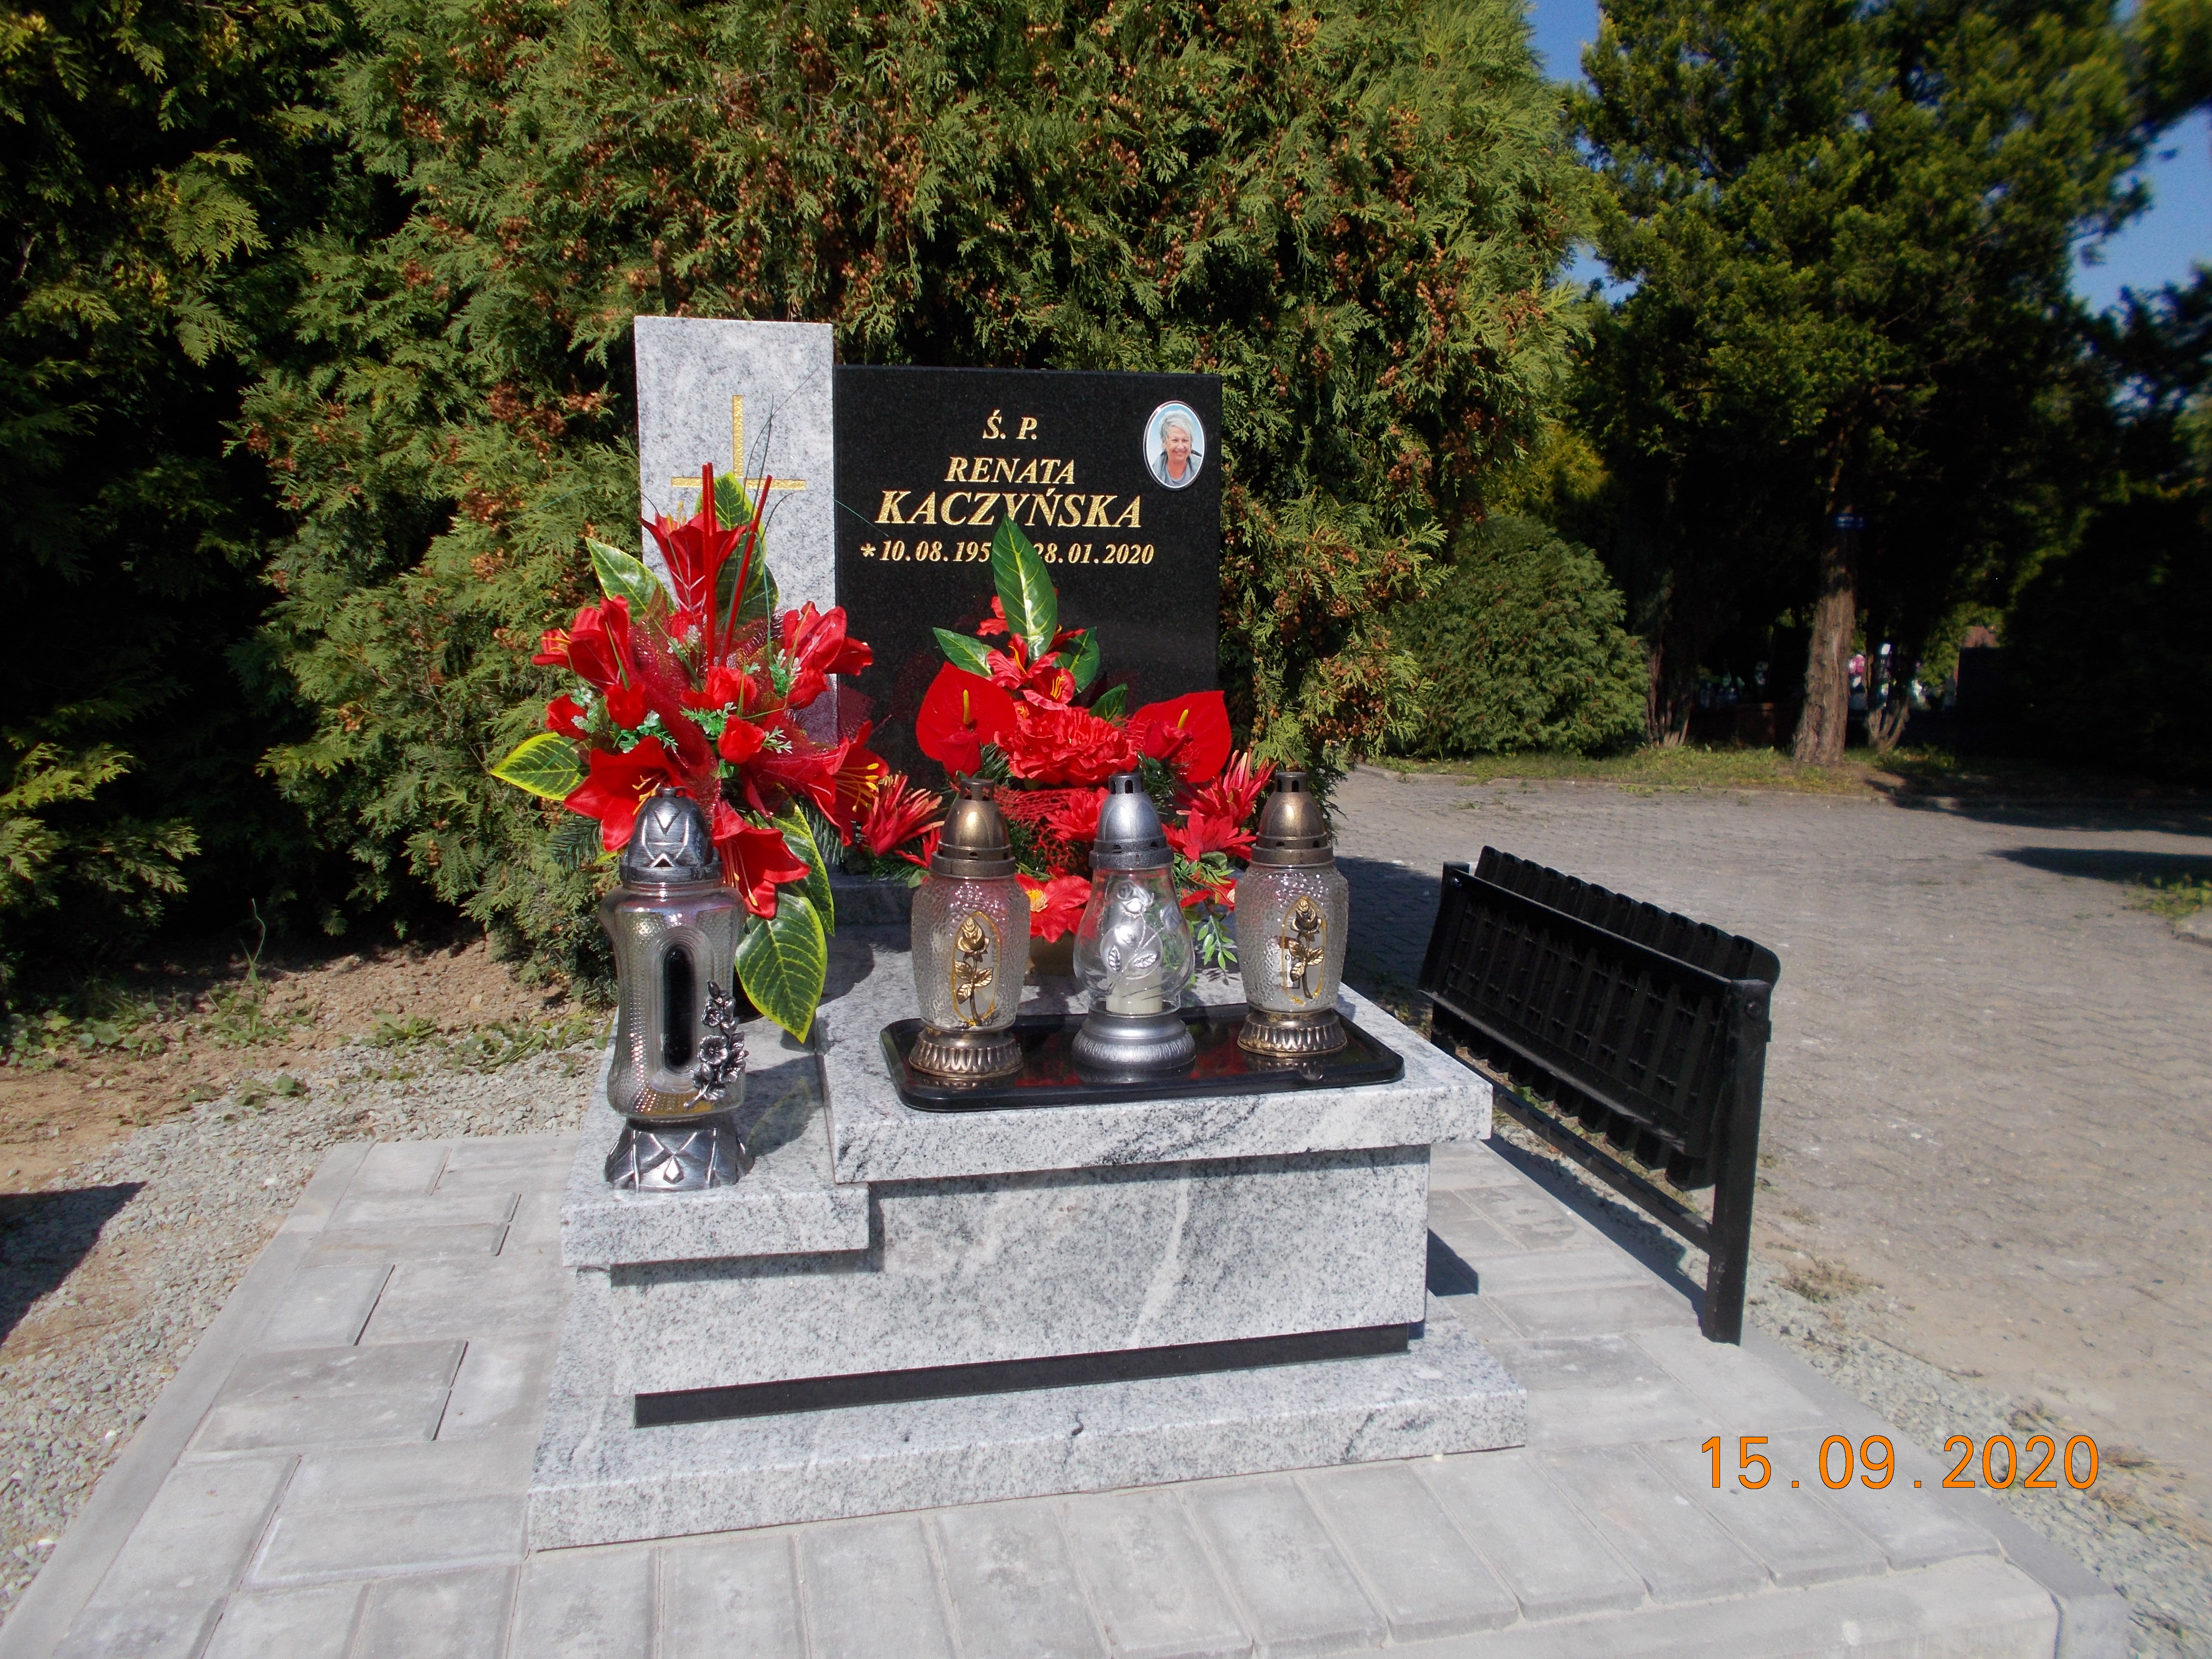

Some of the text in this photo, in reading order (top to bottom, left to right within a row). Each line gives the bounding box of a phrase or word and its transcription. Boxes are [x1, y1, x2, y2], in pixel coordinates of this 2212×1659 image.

[982, 409, 1037, 440] Ś. P.
[944, 456, 1075, 484] RENATA
[874, 487, 1142, 528] KACZYŃSKA
